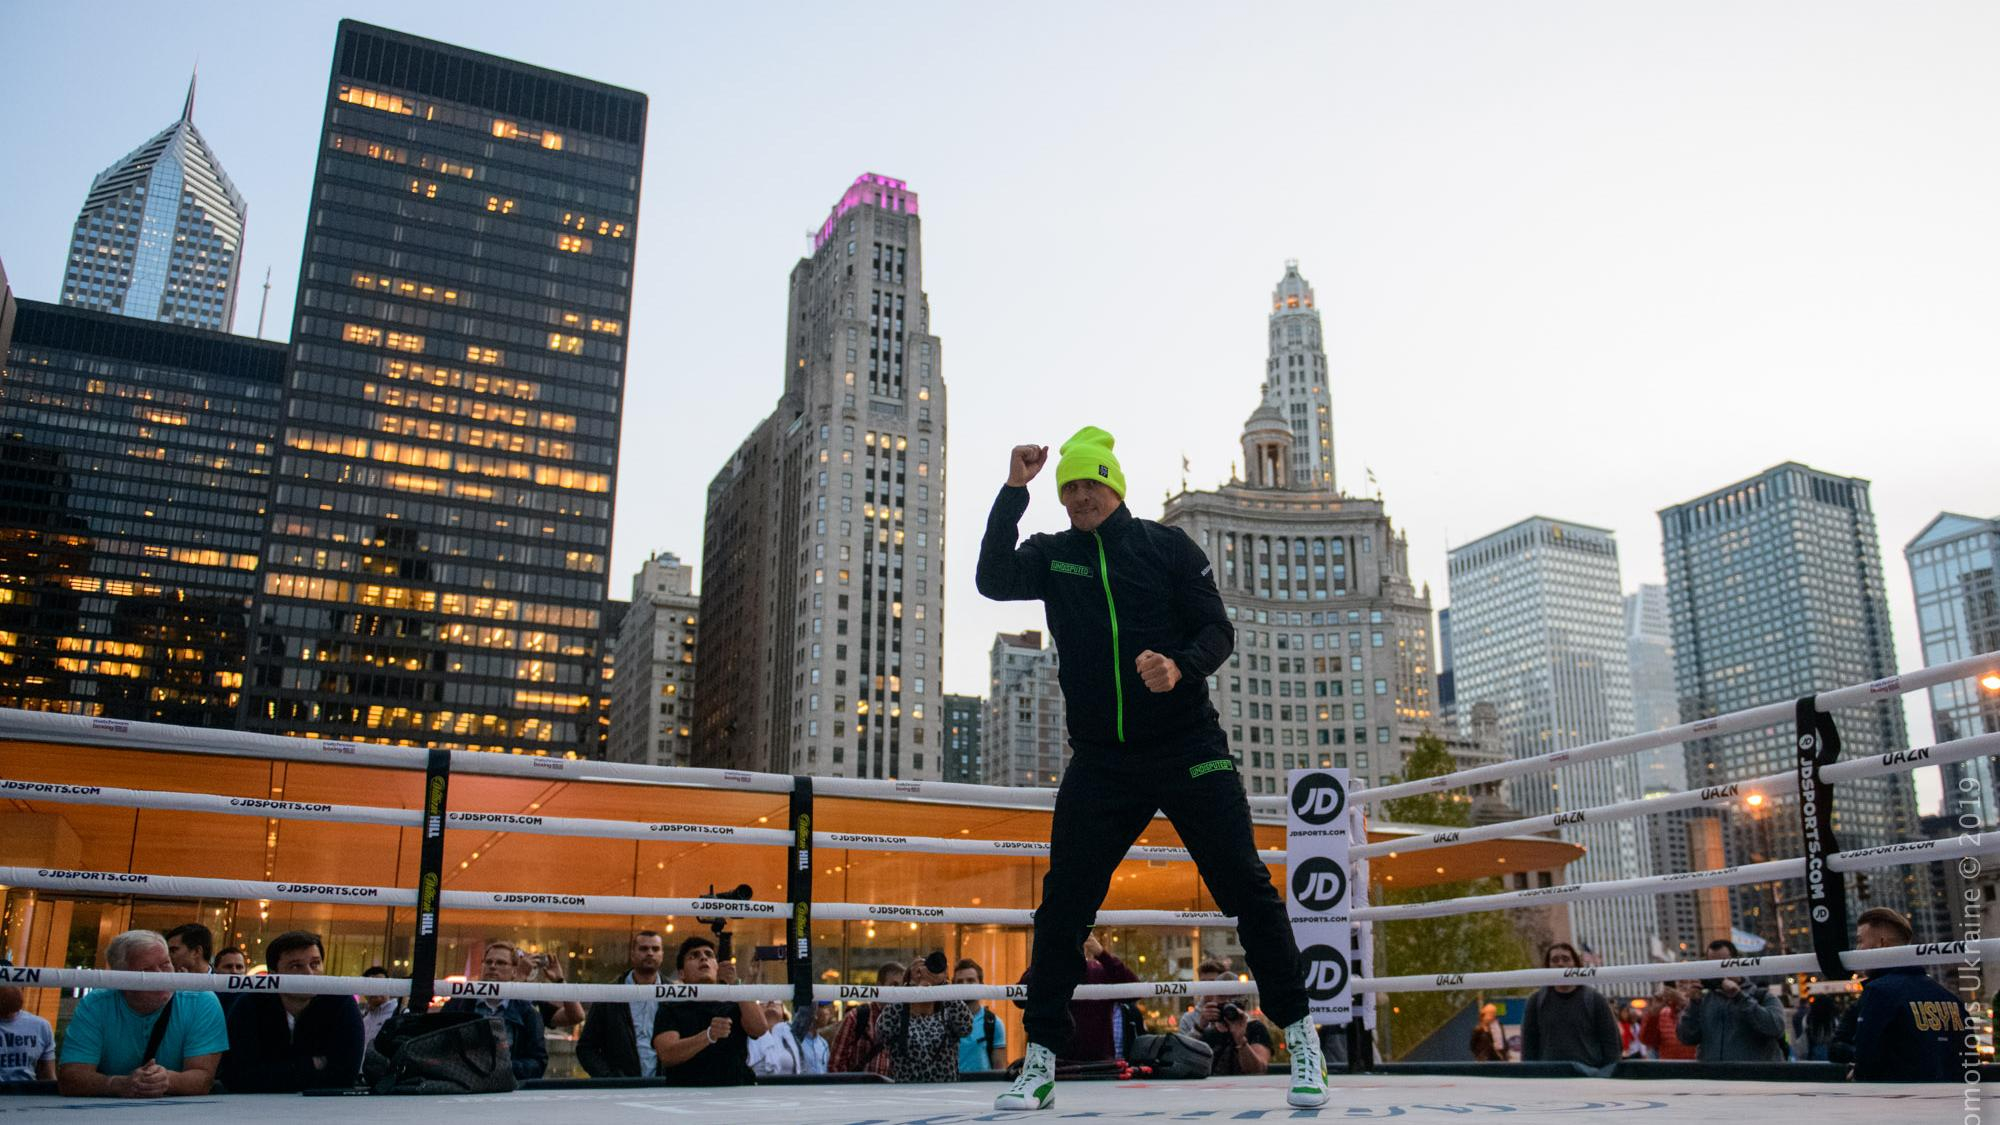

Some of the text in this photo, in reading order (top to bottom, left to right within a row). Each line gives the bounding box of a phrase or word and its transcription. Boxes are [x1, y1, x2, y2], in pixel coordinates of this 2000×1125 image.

[2, 781, 101, 795] JDSPORTS.COM
[240, 799, 332, 812] JDSPORTS.COM
[1298, 787, 1339, 815] JD
[458, 813, 542, 825] JDSPORTS.COM
[428, 816, 441, 838] HILL
[658, 824, 734, 834] JDSPORTS.COM
[1289, 829, 1346, 837] JDSPORTS.COM
[1801, 757, 1825, 900] JDSPORTS.COM
[839, 834, 907, 843] JDSPORTS.COM
[1002, 841, 1050, 849] JDSPORTS.C
[799, 850, 809, 870] HILL
[48, 870, 148, 883] JDSPORTS.COM
[287, 884, 378, 897] JDSPORTS.COM
[1298, 872, 1340, 901] JD
[503, 894, 585, 906] JDSPORTS.COM
[700, 902, 774, 913] JDSPORTS.COM
[877, 906, 944, 916] JDSPORTS.COM
[421, 912, 434, 936] HILL
[798, 938, 808, 959] HILL
[1305, 960, 1342, 990] JD
[228, 975, 280, 990] DAZN
[451, 982, 500, 996] DAZN
[1155, 983, 1187, 995] DAZN
[655, 985, 699, 998] DAZN
[840, 986, 880, 998] DAZN
[1006, 986, 1028, 998] DA
[1909, 1001, 1965, 1032] USYK
[5, 1033, 37, 1049] Very
